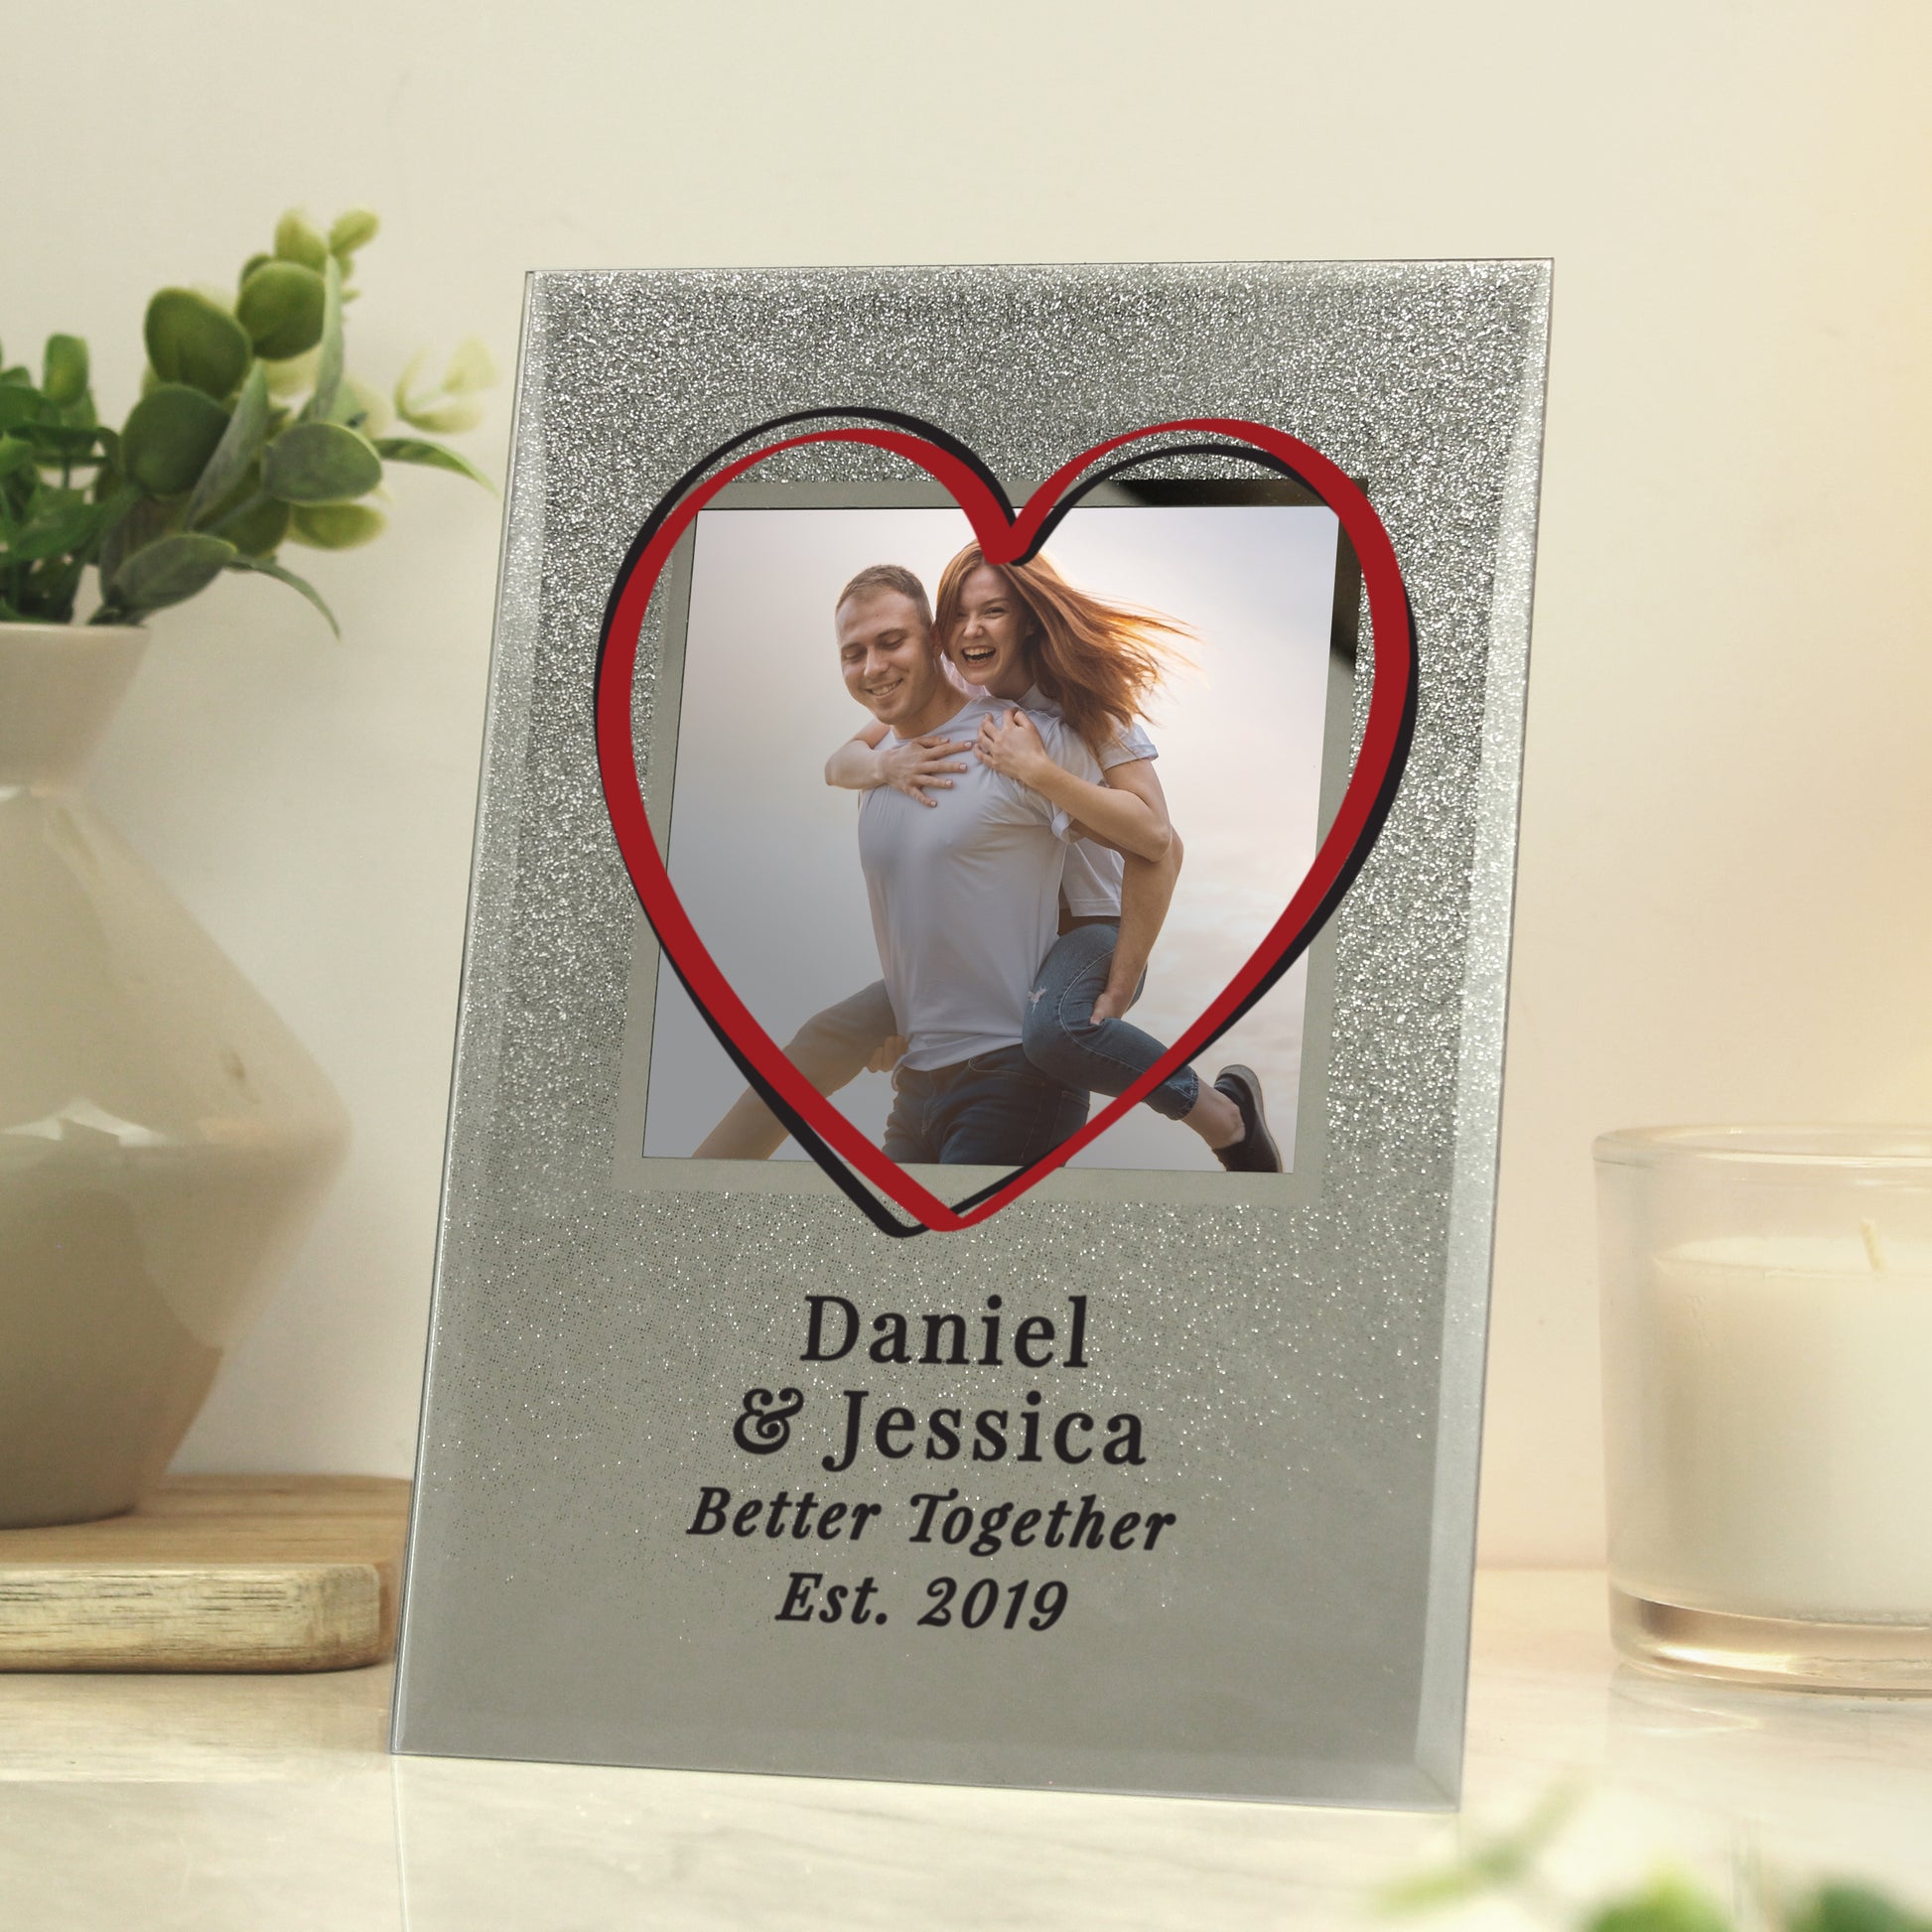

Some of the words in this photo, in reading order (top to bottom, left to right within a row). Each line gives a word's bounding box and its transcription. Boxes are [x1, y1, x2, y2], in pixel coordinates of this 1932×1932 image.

[799, 1294, 1089, 1368] Daniel
[733, 1387, 805, 1455] &
[821, 1389, 1147, 1473] Jessica
[685, 1486, 883, 1541] Better
[908, 1487, 1176, 1558] Together
[774, 1572, 889, 1626] Est.
[916, 1577, 1068, 1632] 2019
